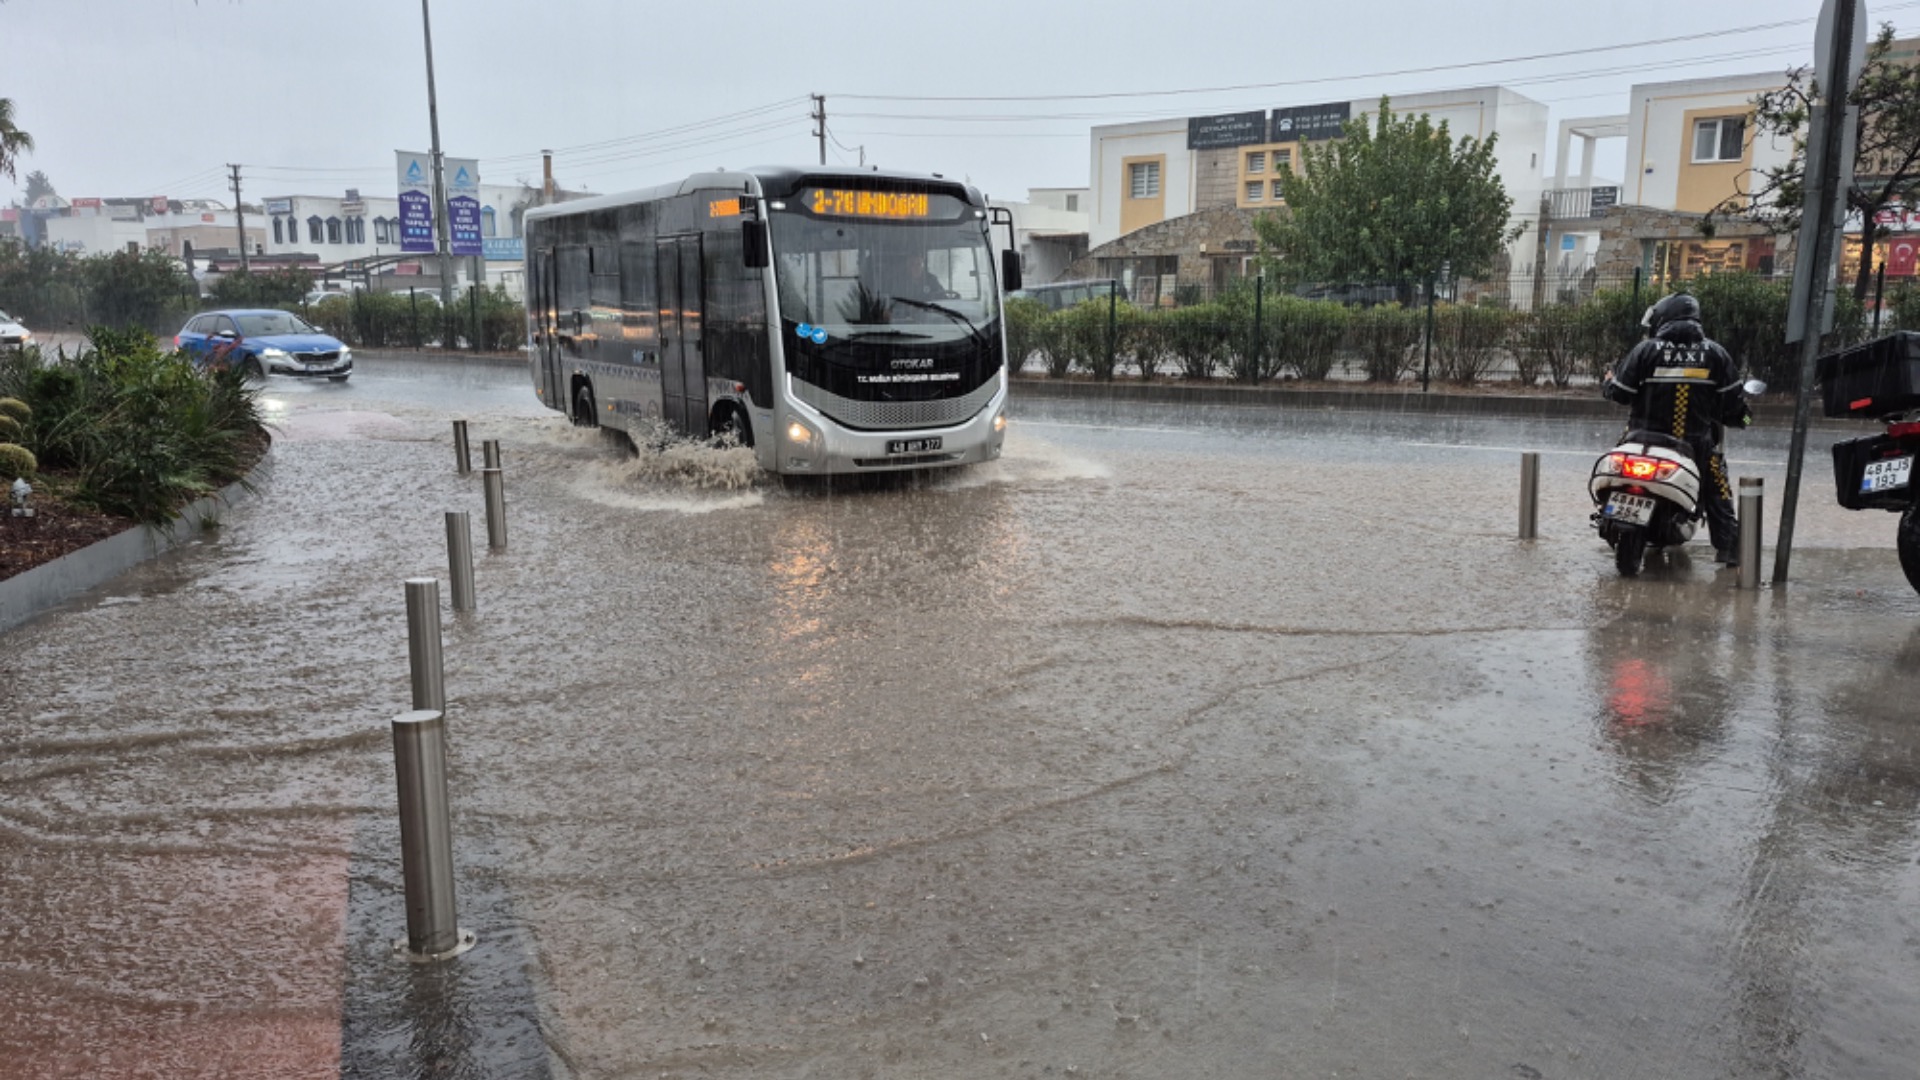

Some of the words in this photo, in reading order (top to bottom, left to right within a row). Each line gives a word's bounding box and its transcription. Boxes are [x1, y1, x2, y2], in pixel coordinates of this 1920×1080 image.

[890, 358, 934, 370] OTOKAR
[1867, 463, 1882, 476] 48
[1885, 458, 1910, 471] AJS
[1874, 473, 1897, 488] 193
